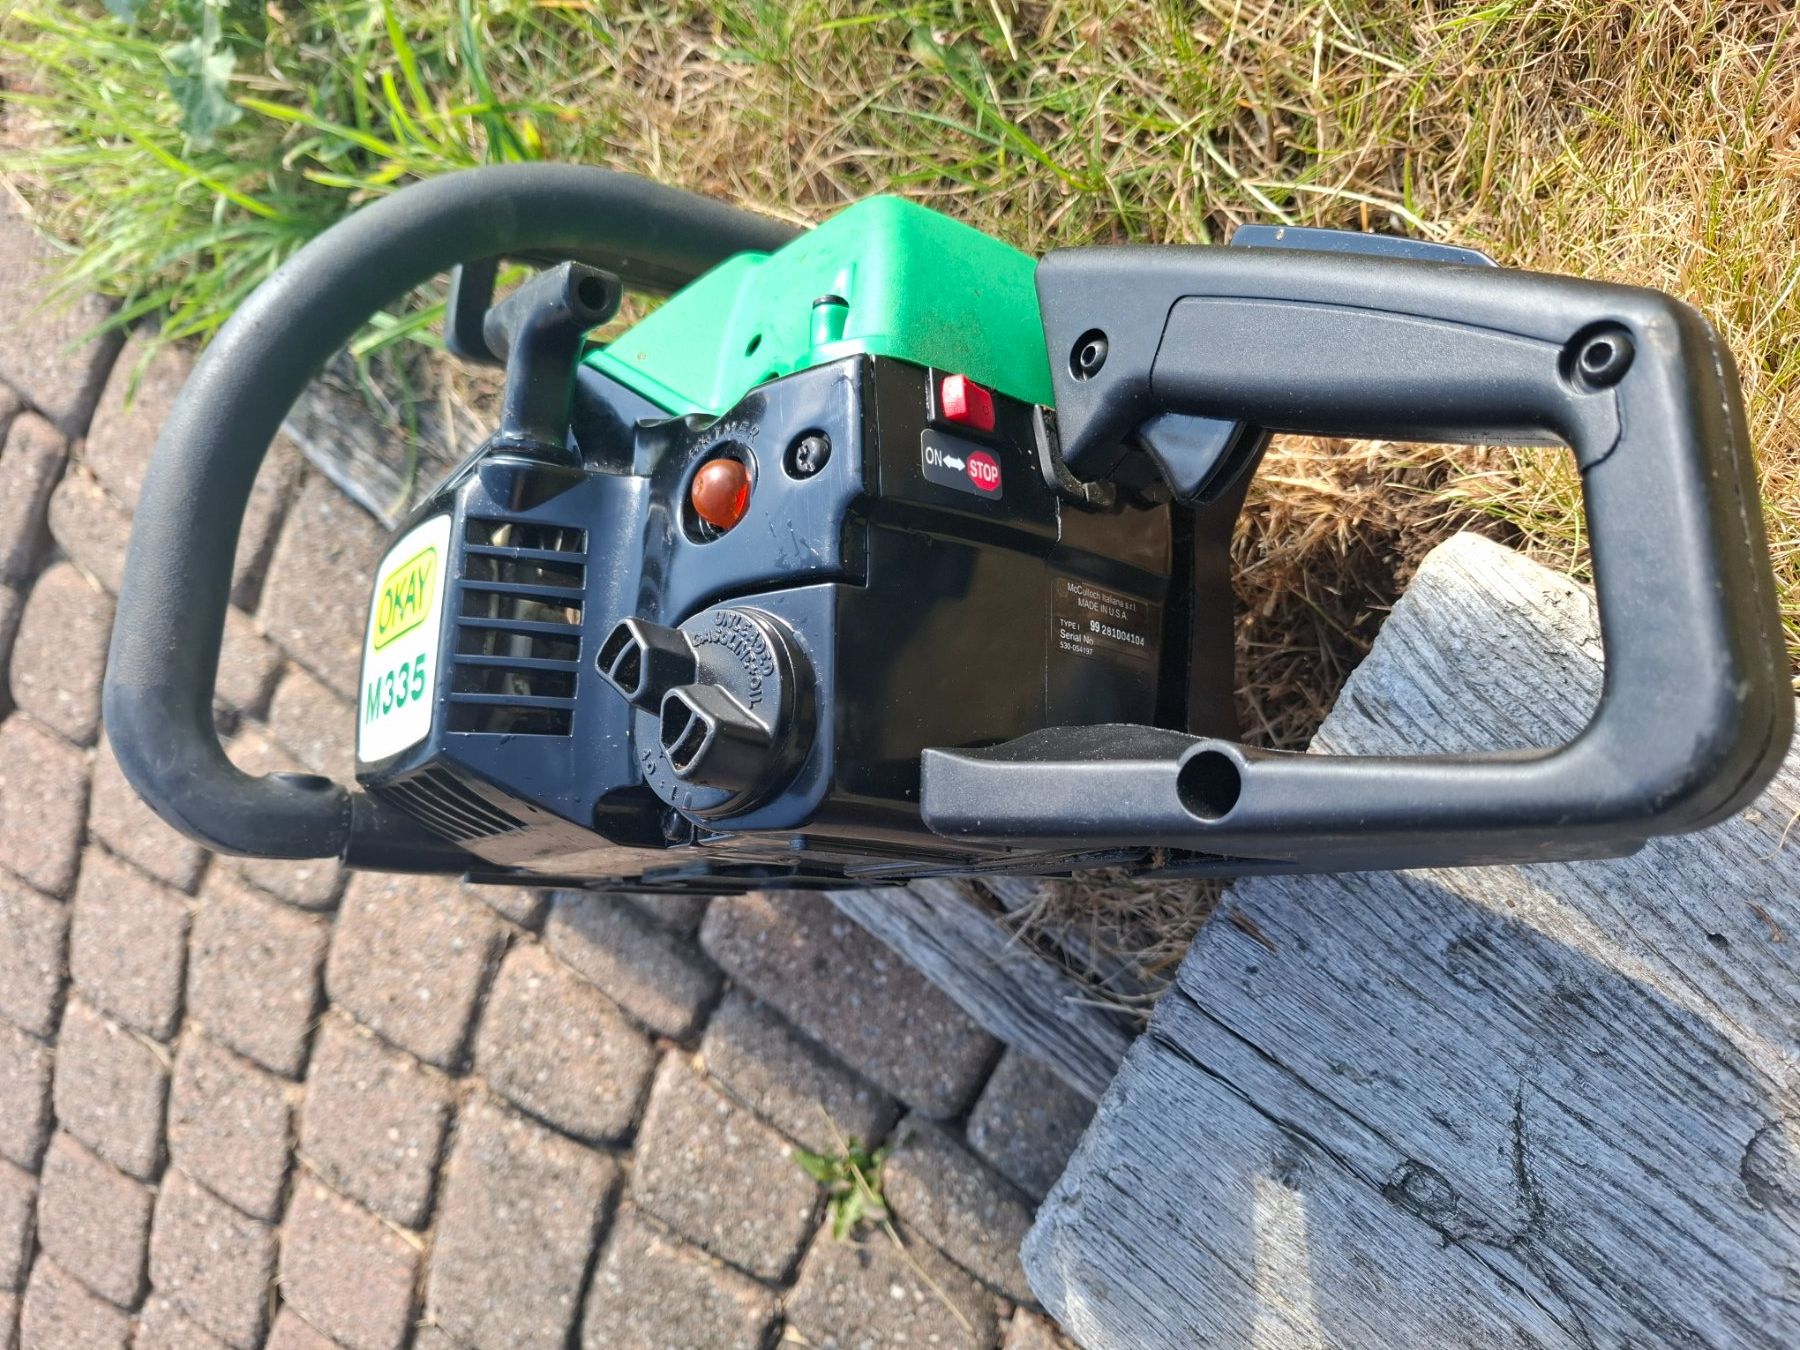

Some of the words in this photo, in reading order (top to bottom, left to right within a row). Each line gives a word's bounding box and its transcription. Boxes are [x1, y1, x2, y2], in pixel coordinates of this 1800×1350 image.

[925, 446, 943, 467] ON
[969, 459, 998, 483] STOP
[378, 560, 432, 635] OKAY
[1067, 582, 1101, 600] McCulloch
[1078, 597, 1099, 611] MADE
[1100, 604, 1108, 614] IN
[1060, 619, 1077, 630] TYPE
[1090, 620, 1100, 633] 99
[714, 611, 774, 677] UNLEADED
[1060, 628, 1082, 642] Serial
[365, 653, 426, 725] M335
